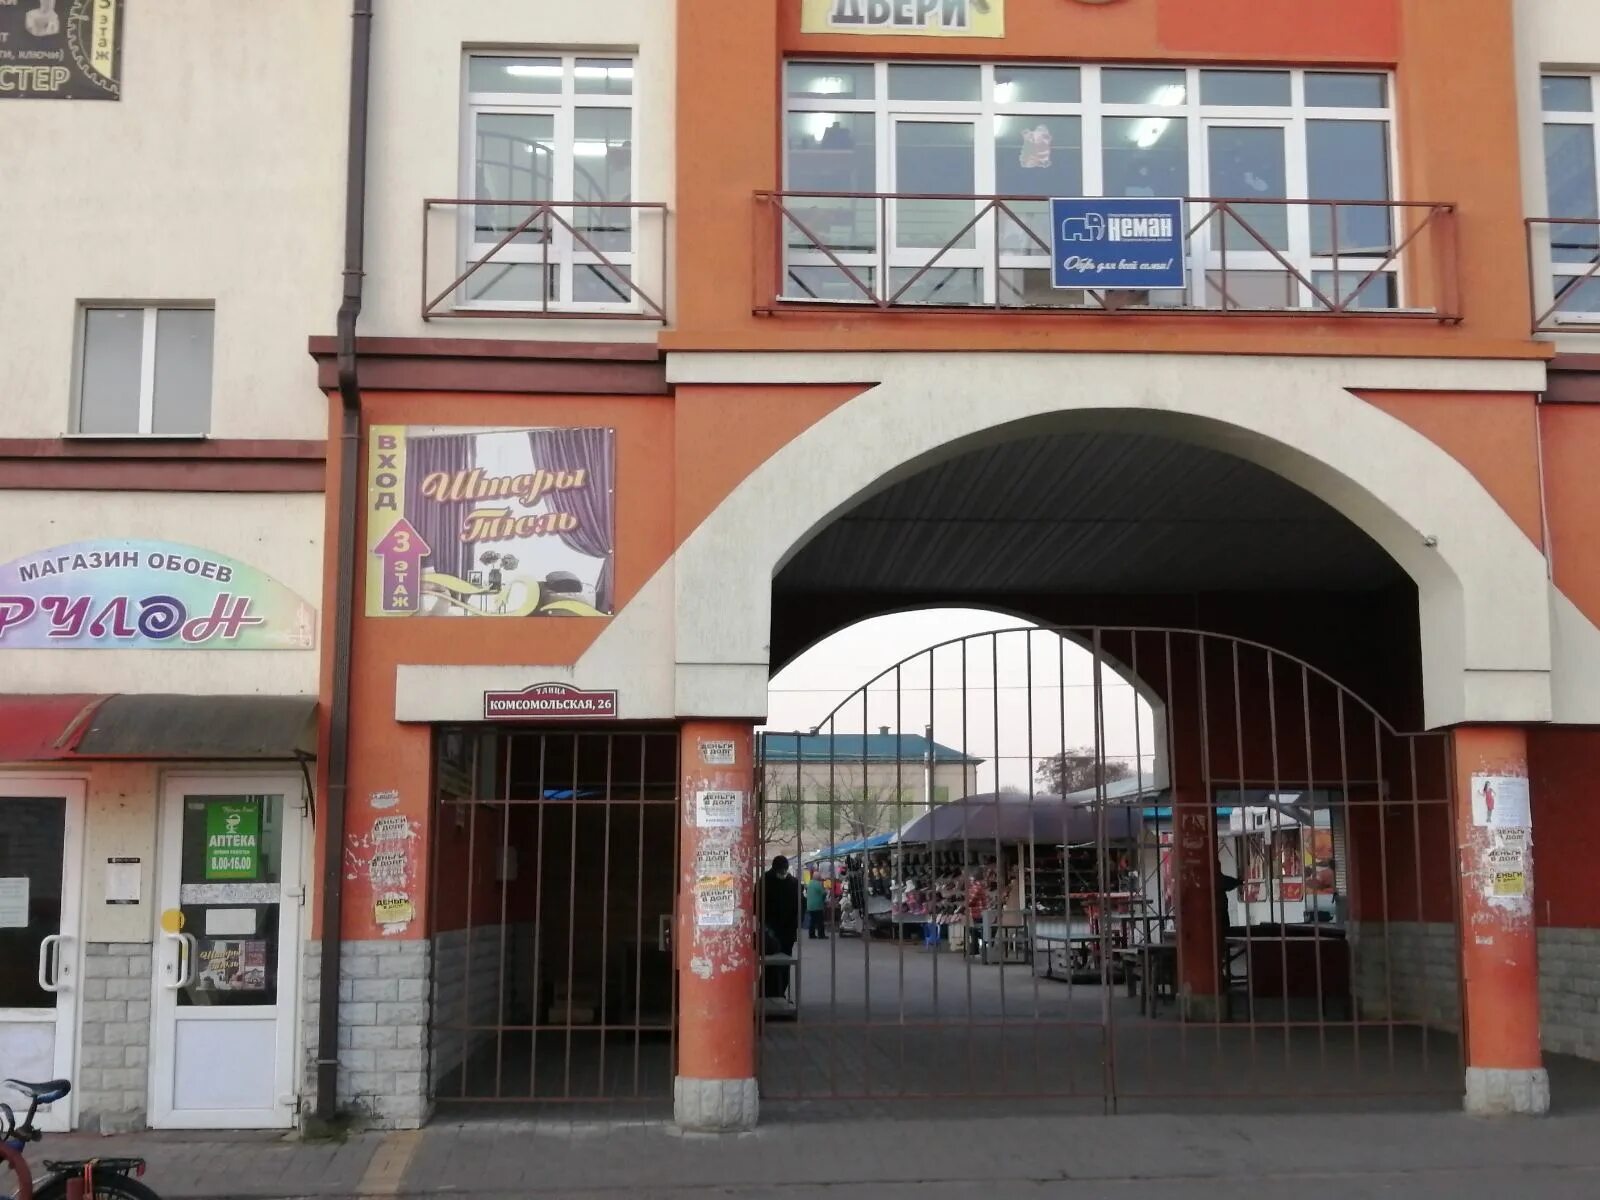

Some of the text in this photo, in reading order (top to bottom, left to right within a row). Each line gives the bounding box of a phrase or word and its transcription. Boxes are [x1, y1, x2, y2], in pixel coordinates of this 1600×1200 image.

[831, 0, 967, 27] ДВЕРИ
[374, 435, 398, 511] ВХОД
[421, 467, 587, 507] Шторы
[459, 507, 579, 543] Тюль
[19, 552, 233, 583] МАГАЗИН ОБОЕВ
[391, 530, 411, 608] 3 ЭТАЖ
[0, 593, 264, 642] РУЛОН
[490, 699, 612, 711] КОМСОМОЛЬСКАЯ, 26
[536, 687, 566, 695] УЛИЦА
[208, 834, 256, 849] АПТЕКА
[211, 856, 251, 870] 8.00-16.00
